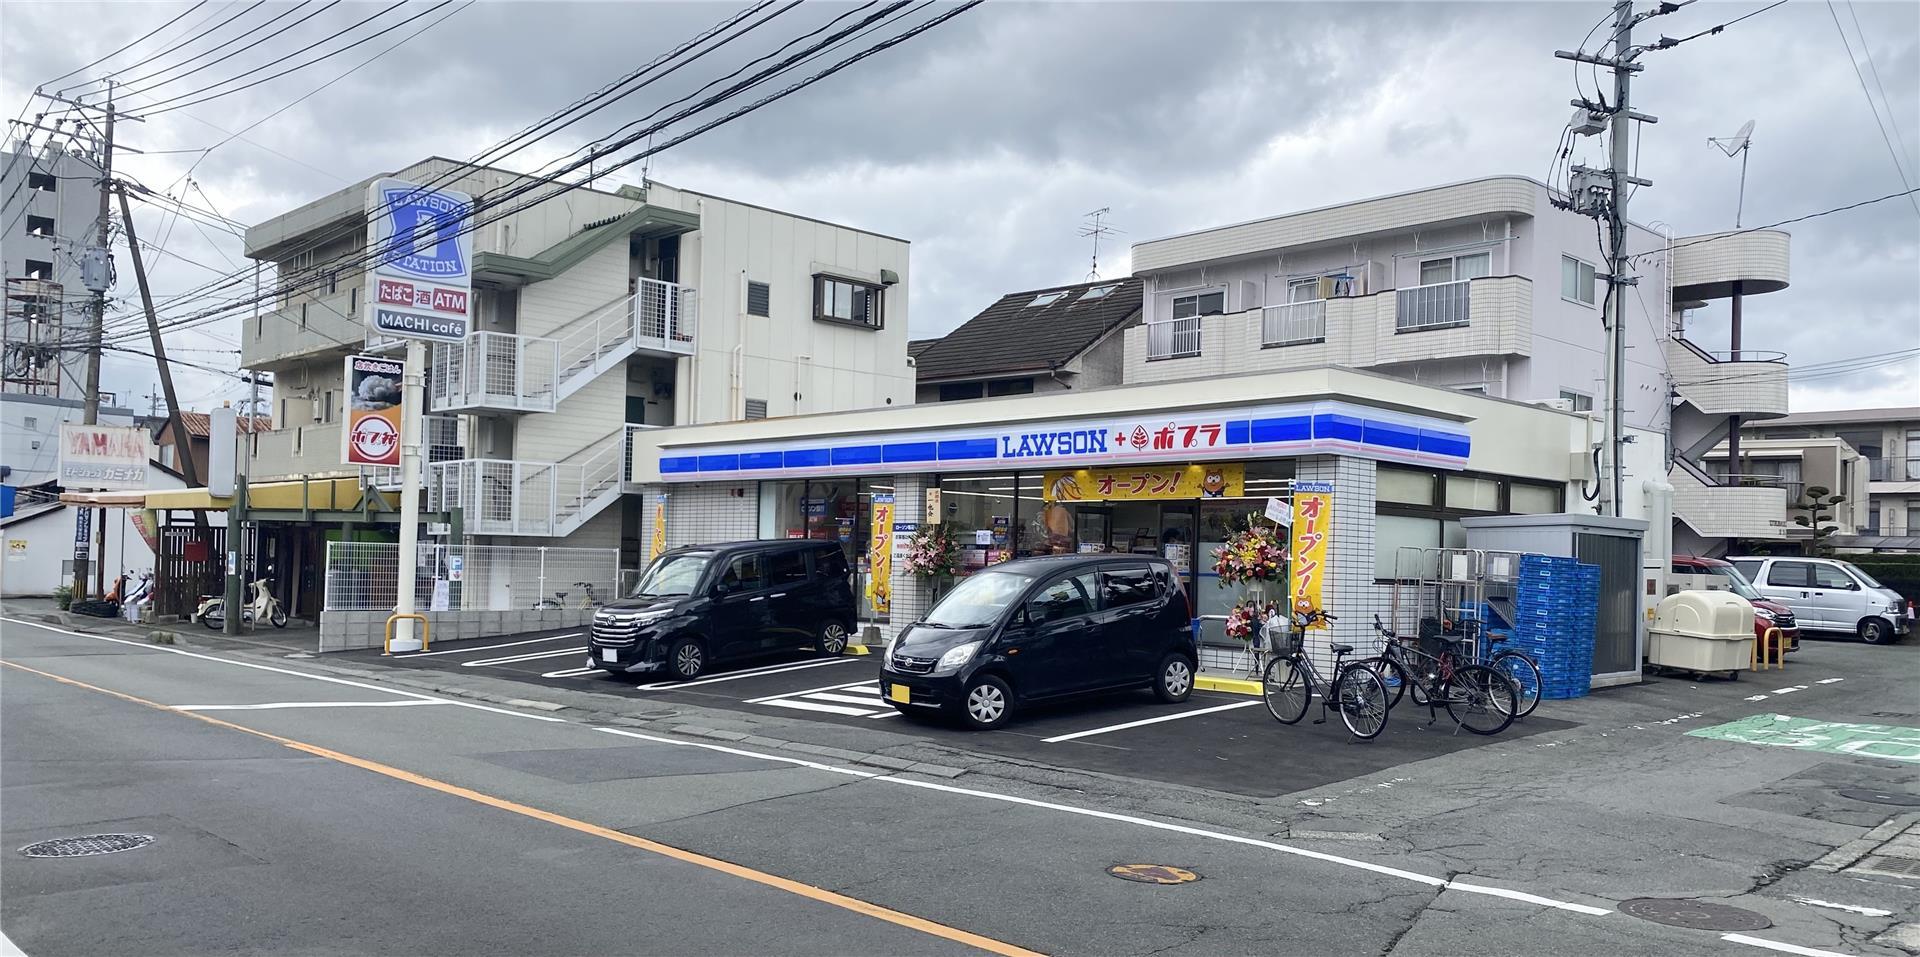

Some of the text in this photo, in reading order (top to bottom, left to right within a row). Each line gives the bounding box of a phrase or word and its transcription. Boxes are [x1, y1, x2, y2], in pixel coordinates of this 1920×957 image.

[380, 283, 413, 303] たばこ
[434, 295, 465, 310] ATM
[381, 313, 463, 335] MACHI café
[68, 431, 145, 457] YAMAHA
[1002, 429, 1108, 458] LAWSON
[1154, 422, 1221, 449] ポプラ
[1098, 471, 1181, 495] オープン!
